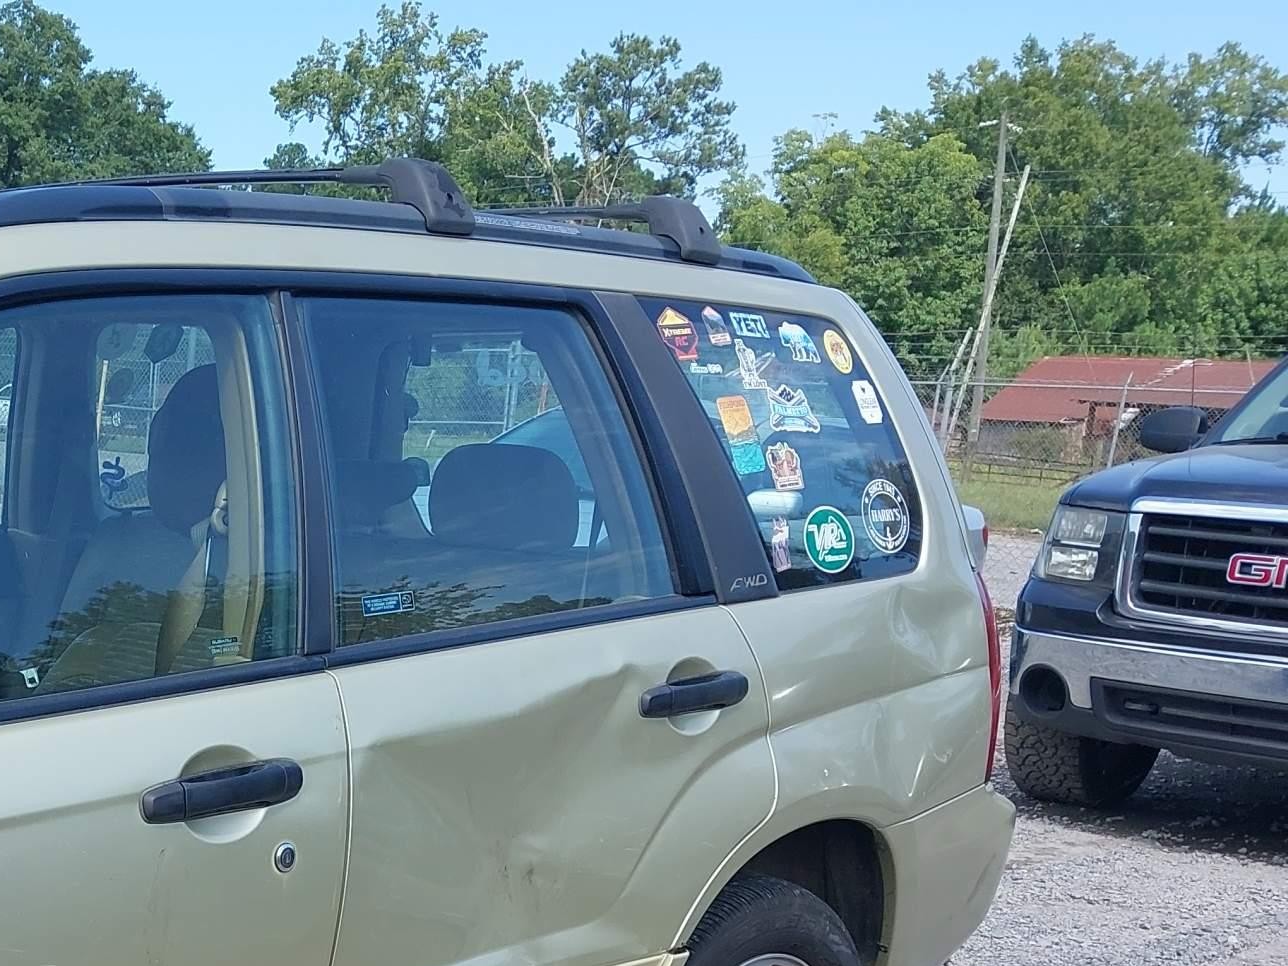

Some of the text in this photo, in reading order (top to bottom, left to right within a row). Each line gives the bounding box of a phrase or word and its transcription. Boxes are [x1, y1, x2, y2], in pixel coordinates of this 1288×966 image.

[733, 316, 768, 337] YETI
[870, 508, 901, 523] HARRY'S
[1226, 553, 1288, 588] G
